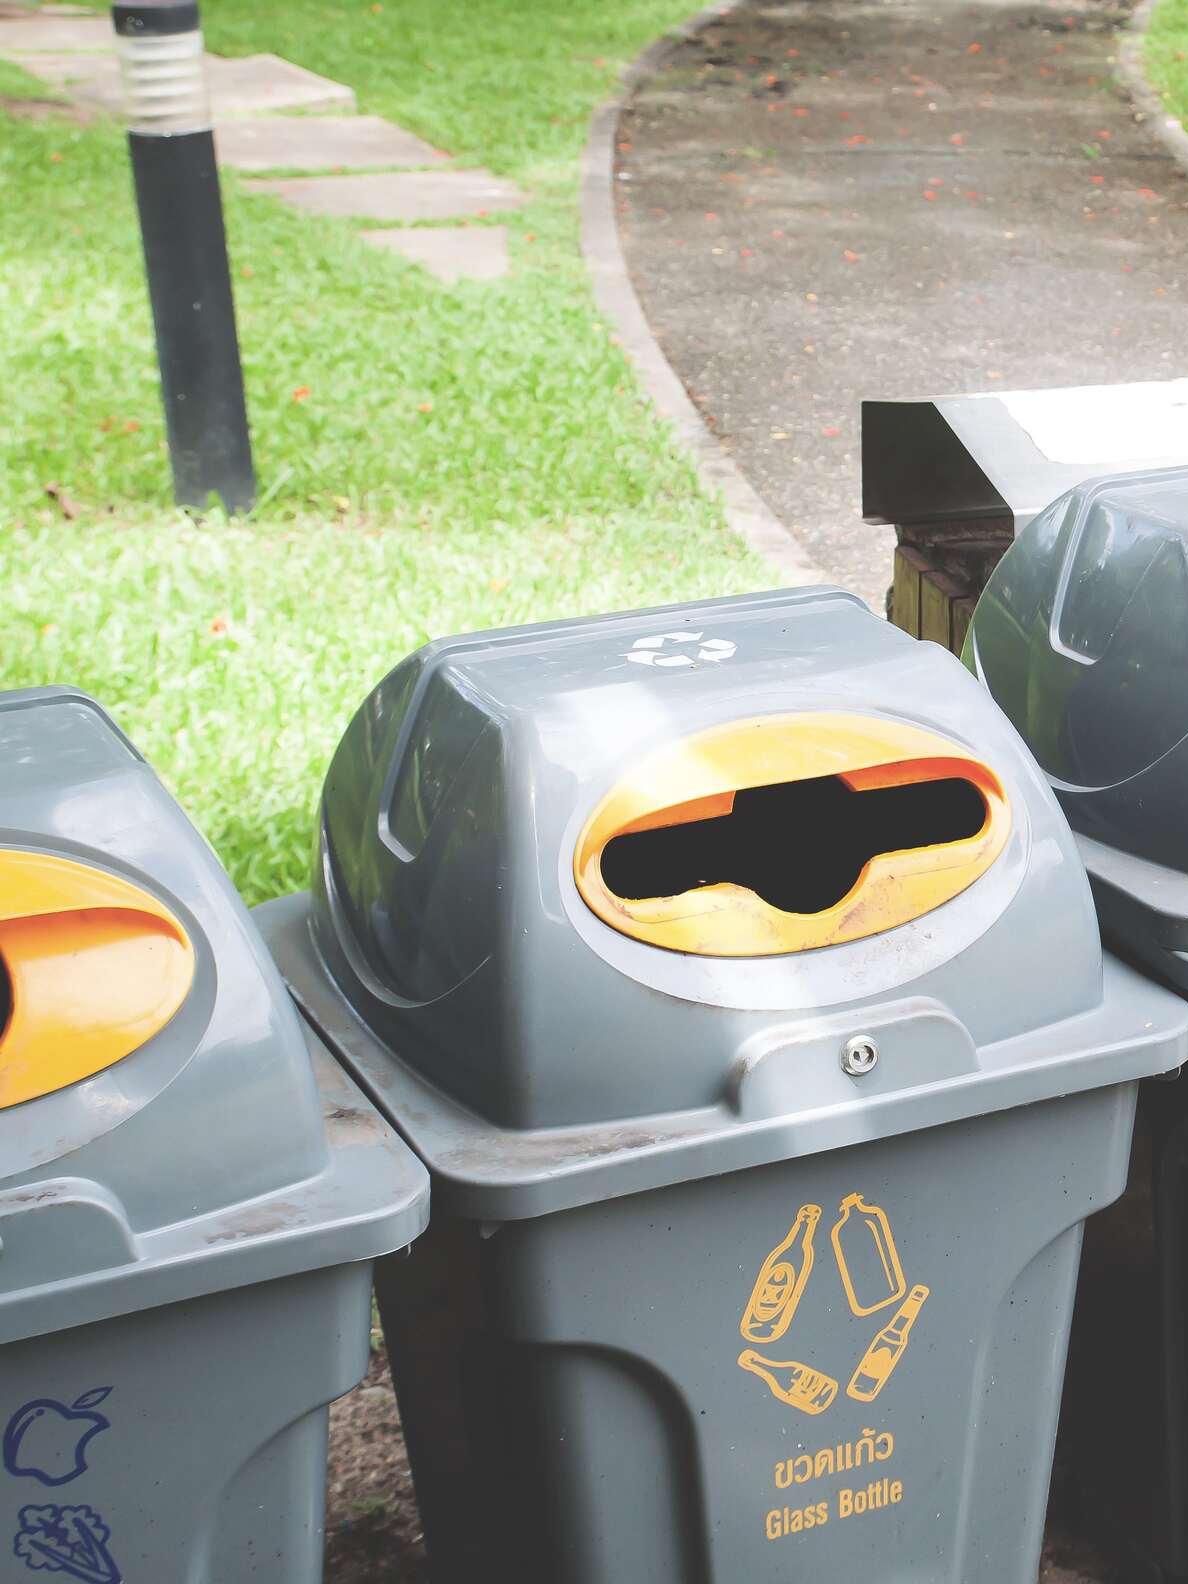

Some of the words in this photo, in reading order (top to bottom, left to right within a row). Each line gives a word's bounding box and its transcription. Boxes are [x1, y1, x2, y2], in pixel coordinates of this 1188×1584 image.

[775, 1428, 894, 1489] ขวดแก้ว
[766, 1501, 829, 1540] Glass
[839, 1478, 903, 1519] Bottle
